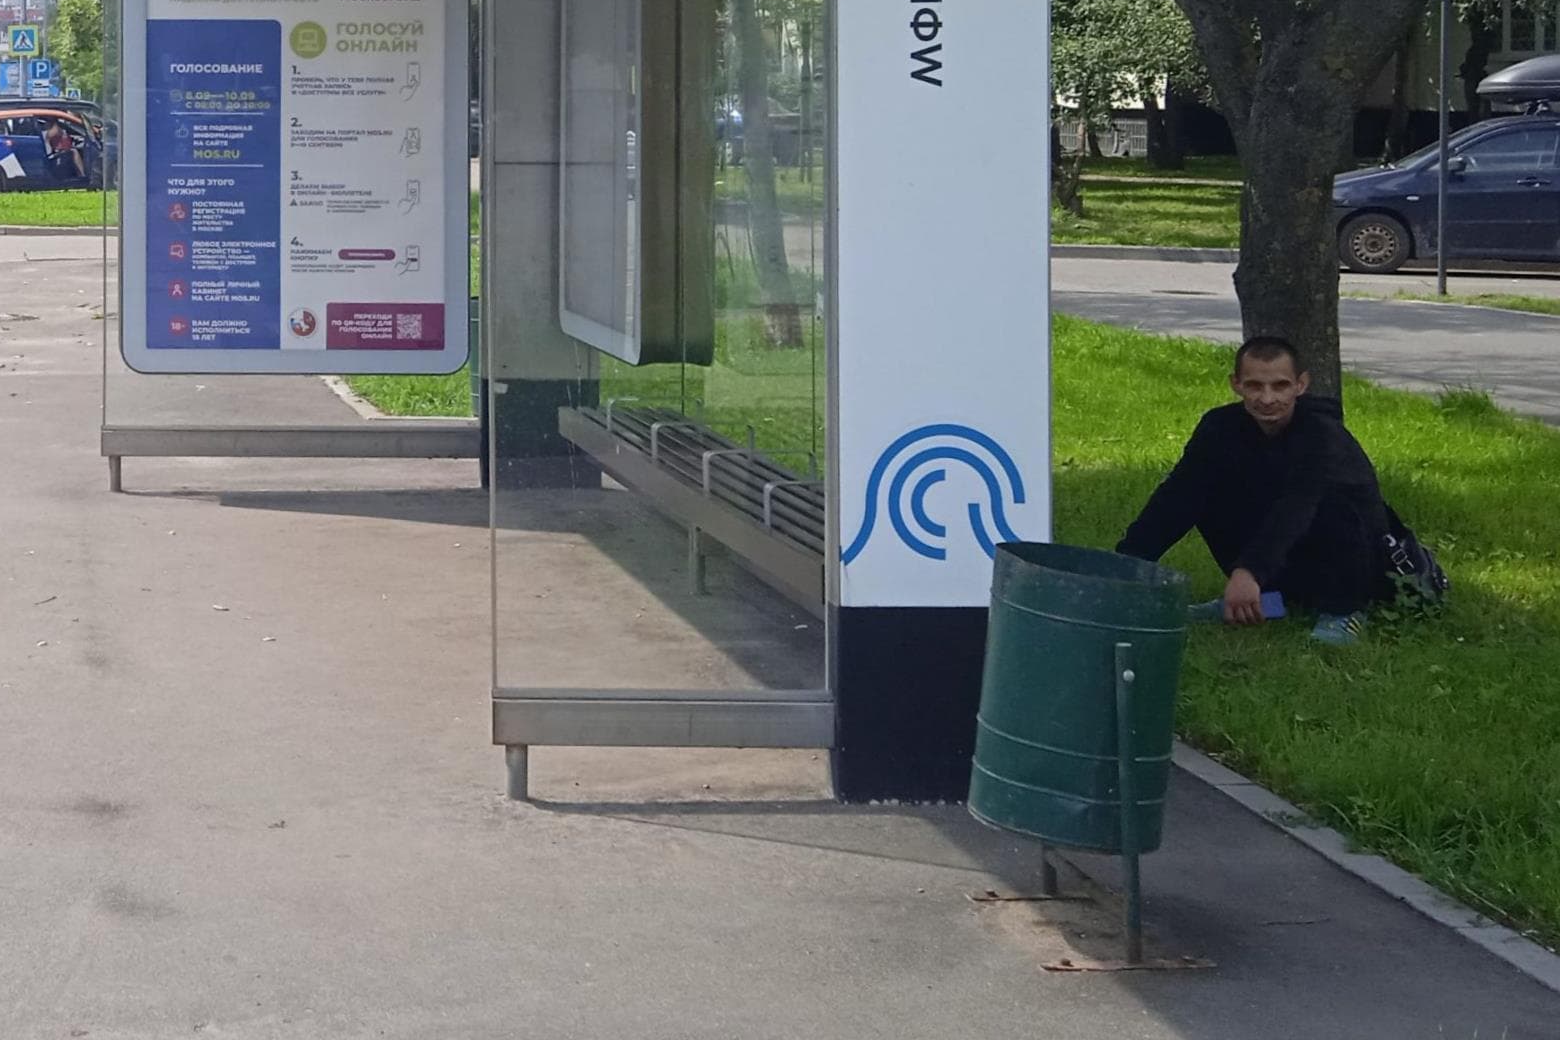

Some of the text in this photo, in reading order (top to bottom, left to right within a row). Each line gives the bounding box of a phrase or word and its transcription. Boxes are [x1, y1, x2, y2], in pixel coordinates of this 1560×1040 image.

[336, 19, 424, 36] ГОЛОСУЙ
[336, 37, 417, 53] ОНЛАЙН
[36, 62, 47, 78] P
[170, 63, 263, 74] ГОЛОСОВАНИЕ
[292, 65, 300, 75] 1.
[291, 117, 302, 127] 2.
[193, 149, 240, 159] MOS.RU
[291, 170, 302, 181] 3.
[186, 179, 205, 187] ДЛЯ
[290, 236, 304, 247] 4.
